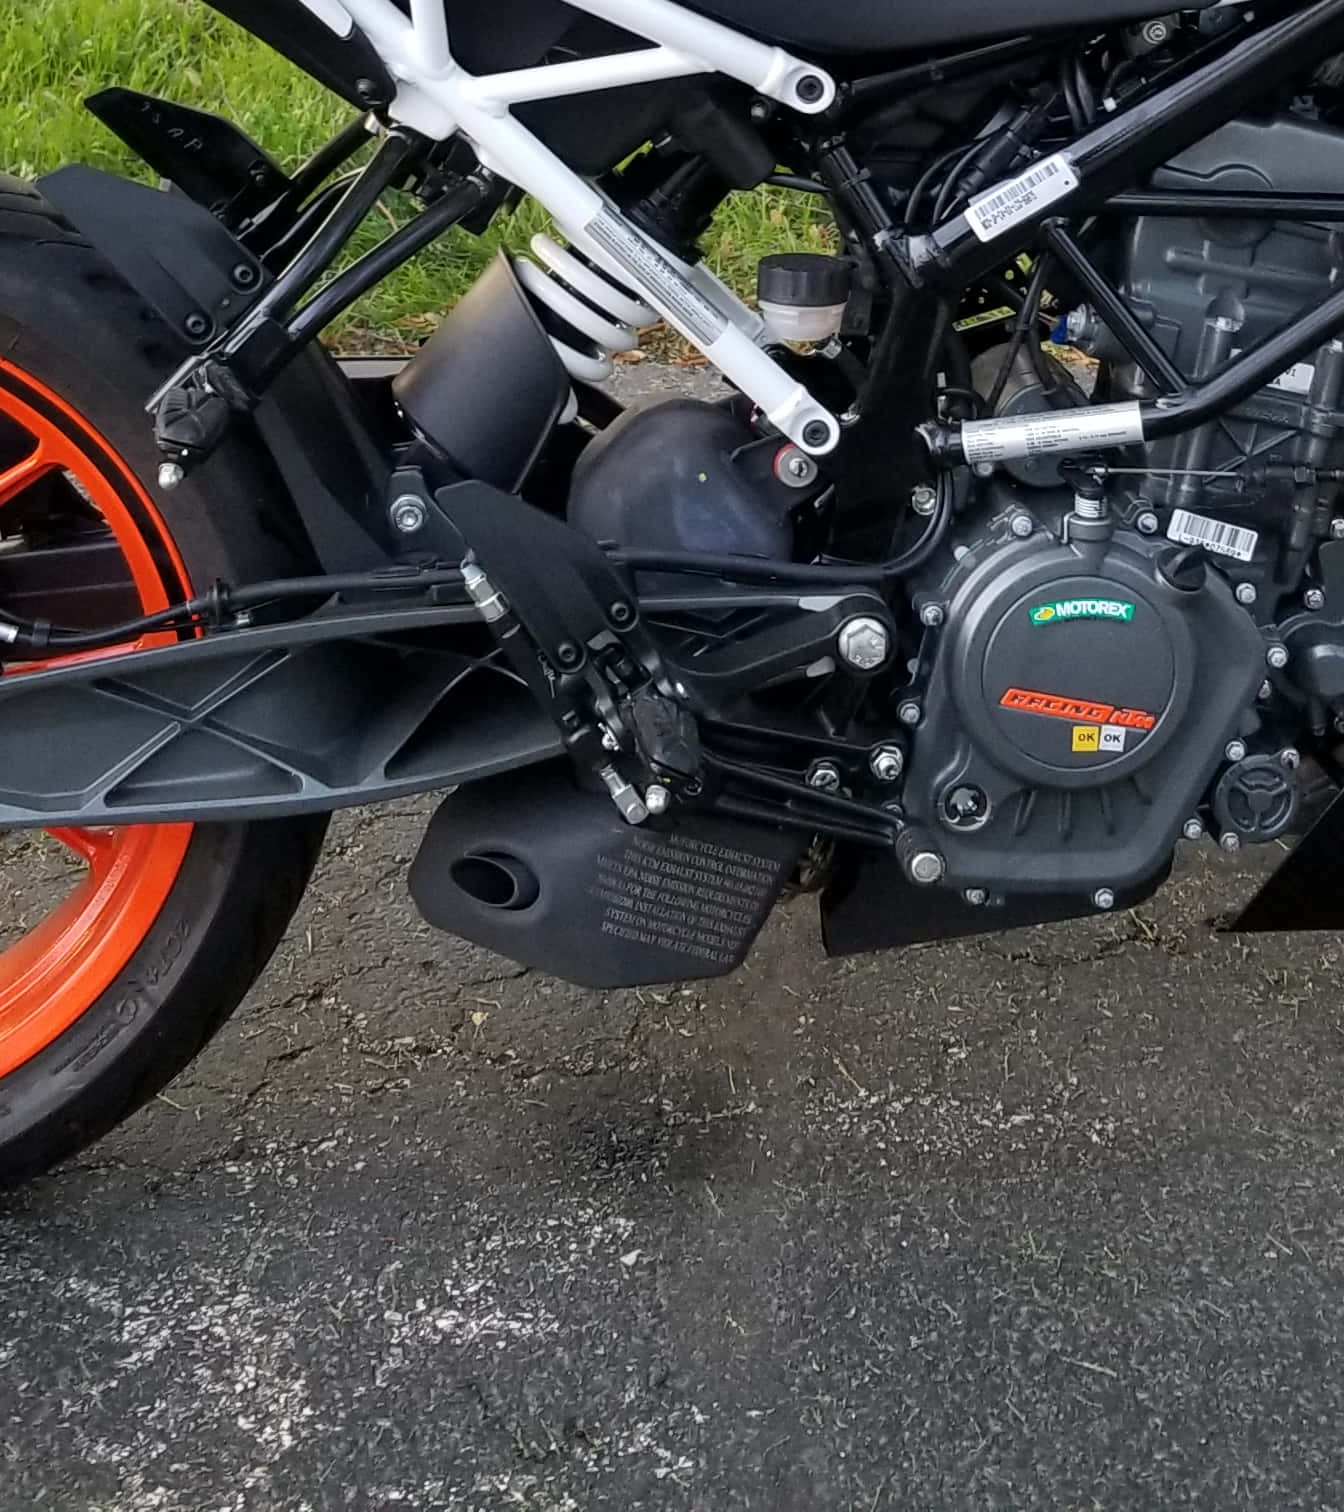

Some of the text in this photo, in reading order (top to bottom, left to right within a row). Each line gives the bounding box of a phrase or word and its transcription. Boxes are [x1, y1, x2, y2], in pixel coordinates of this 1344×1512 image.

[1056, 600, 1131, 619] MOTOREX
[1078, 732, 1096, 743] OK
[1103, 732, 1121, 744] OK
